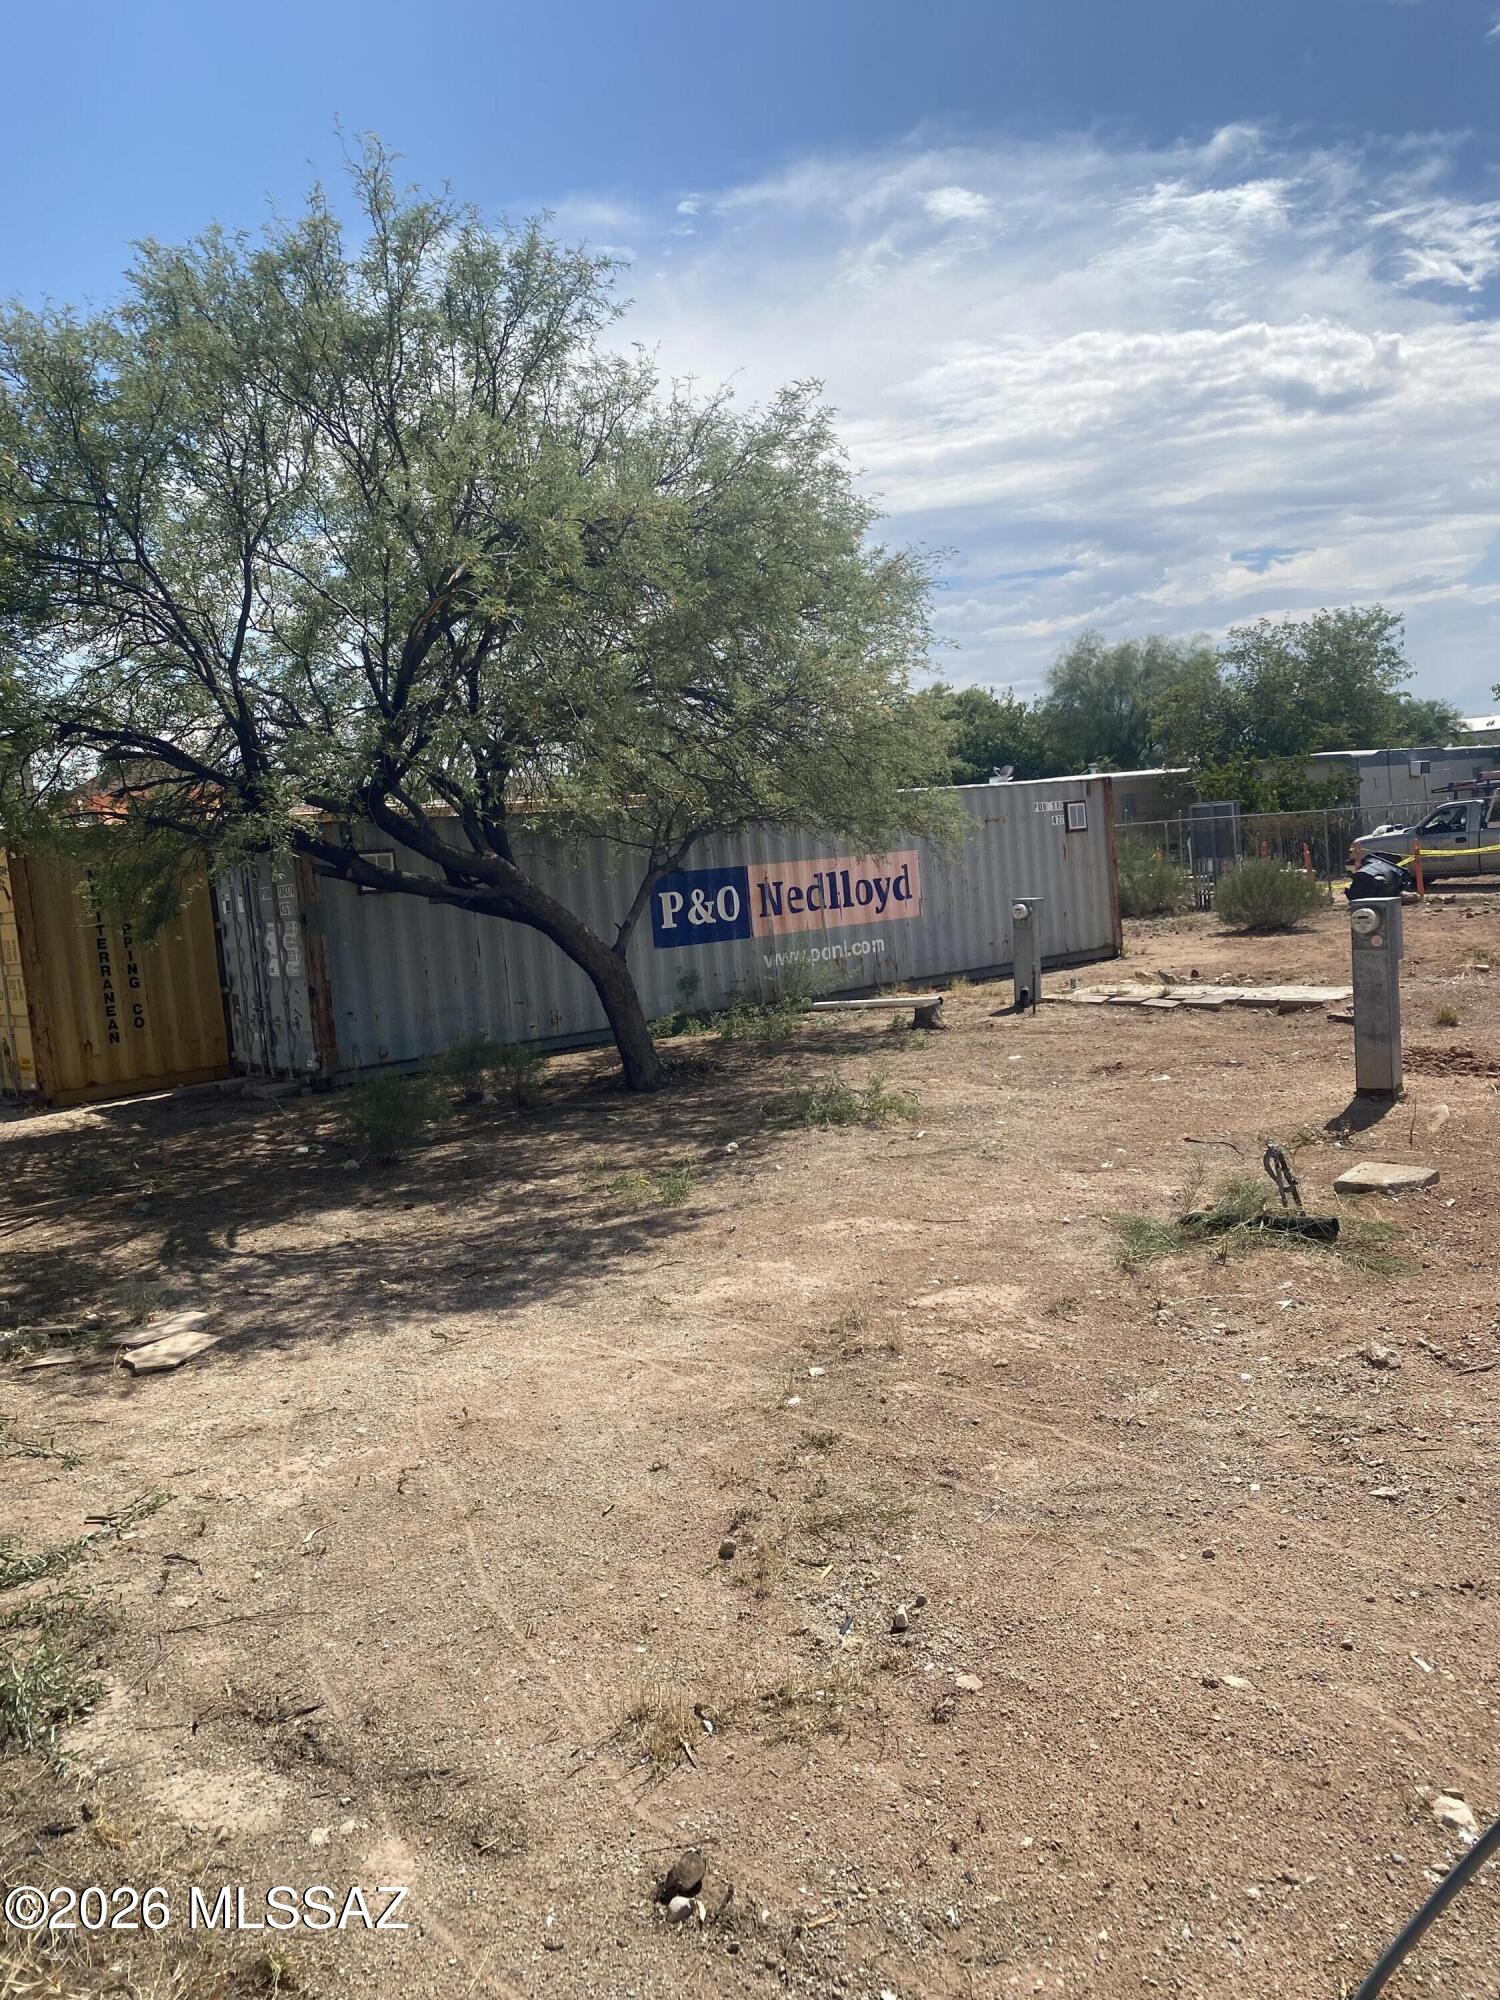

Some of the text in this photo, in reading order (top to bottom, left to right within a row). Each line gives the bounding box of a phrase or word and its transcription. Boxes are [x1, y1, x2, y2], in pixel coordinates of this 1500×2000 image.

[658, 863, 912, 929] P&O Nedlloyd
[132, 1003, 145, 1029] CO
